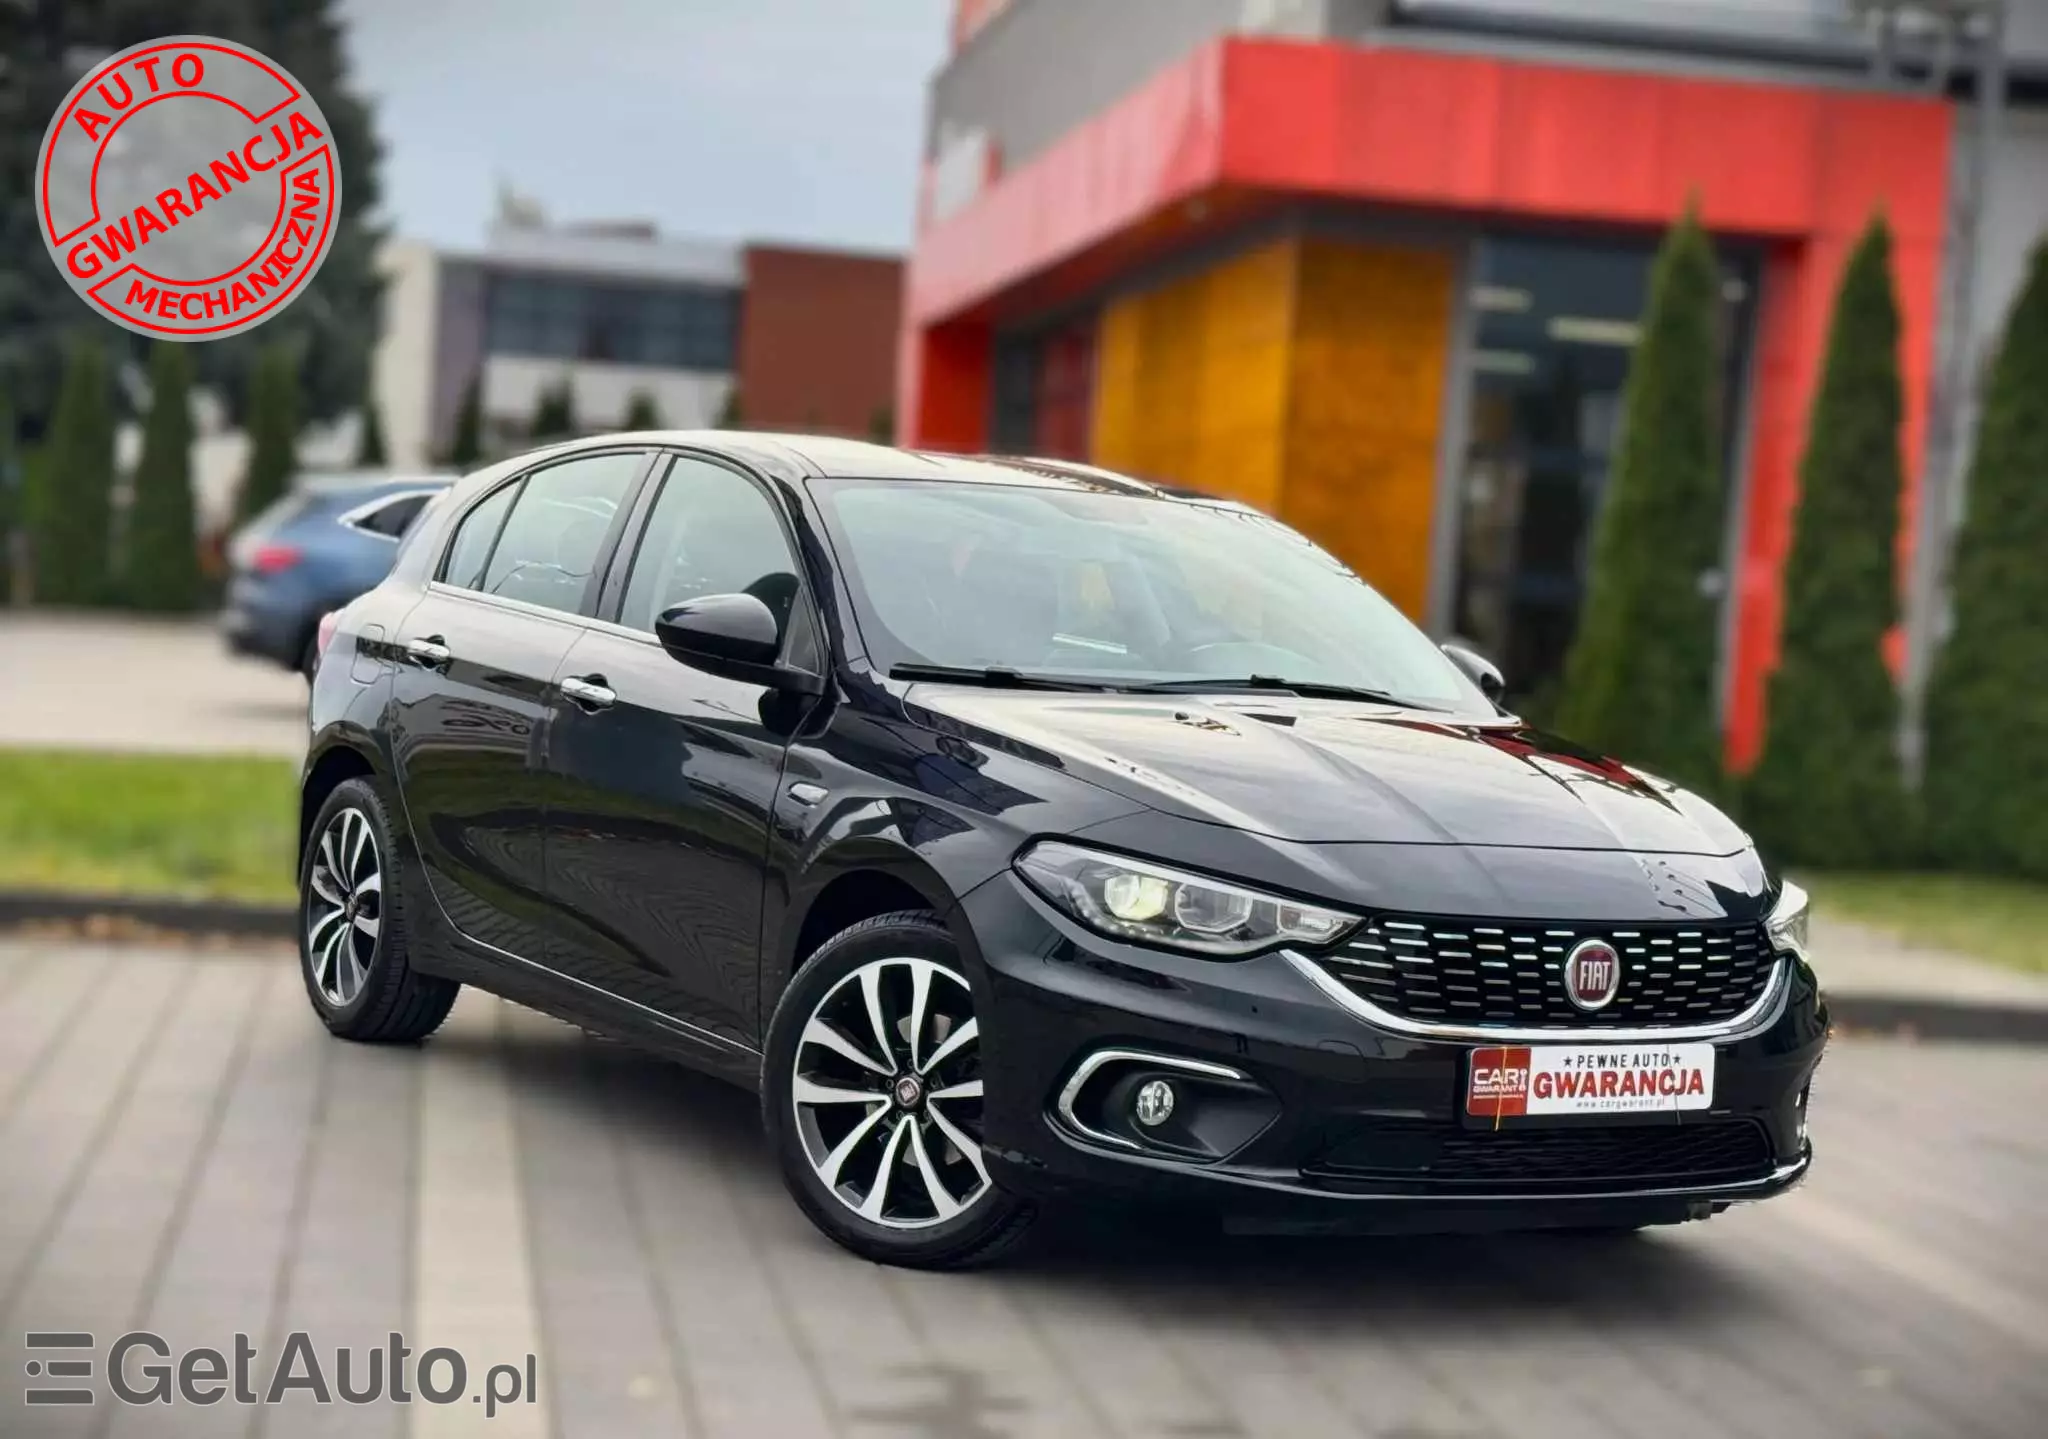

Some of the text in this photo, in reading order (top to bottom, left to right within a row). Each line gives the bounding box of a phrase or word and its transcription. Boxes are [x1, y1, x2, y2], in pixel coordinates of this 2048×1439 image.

[1579, 961, 1611, 990] FIAT
[1577, 1053, 1669, 1068] PEWNE AUTO
[1533, 1068, 1705, 1099] GWARANCJA
